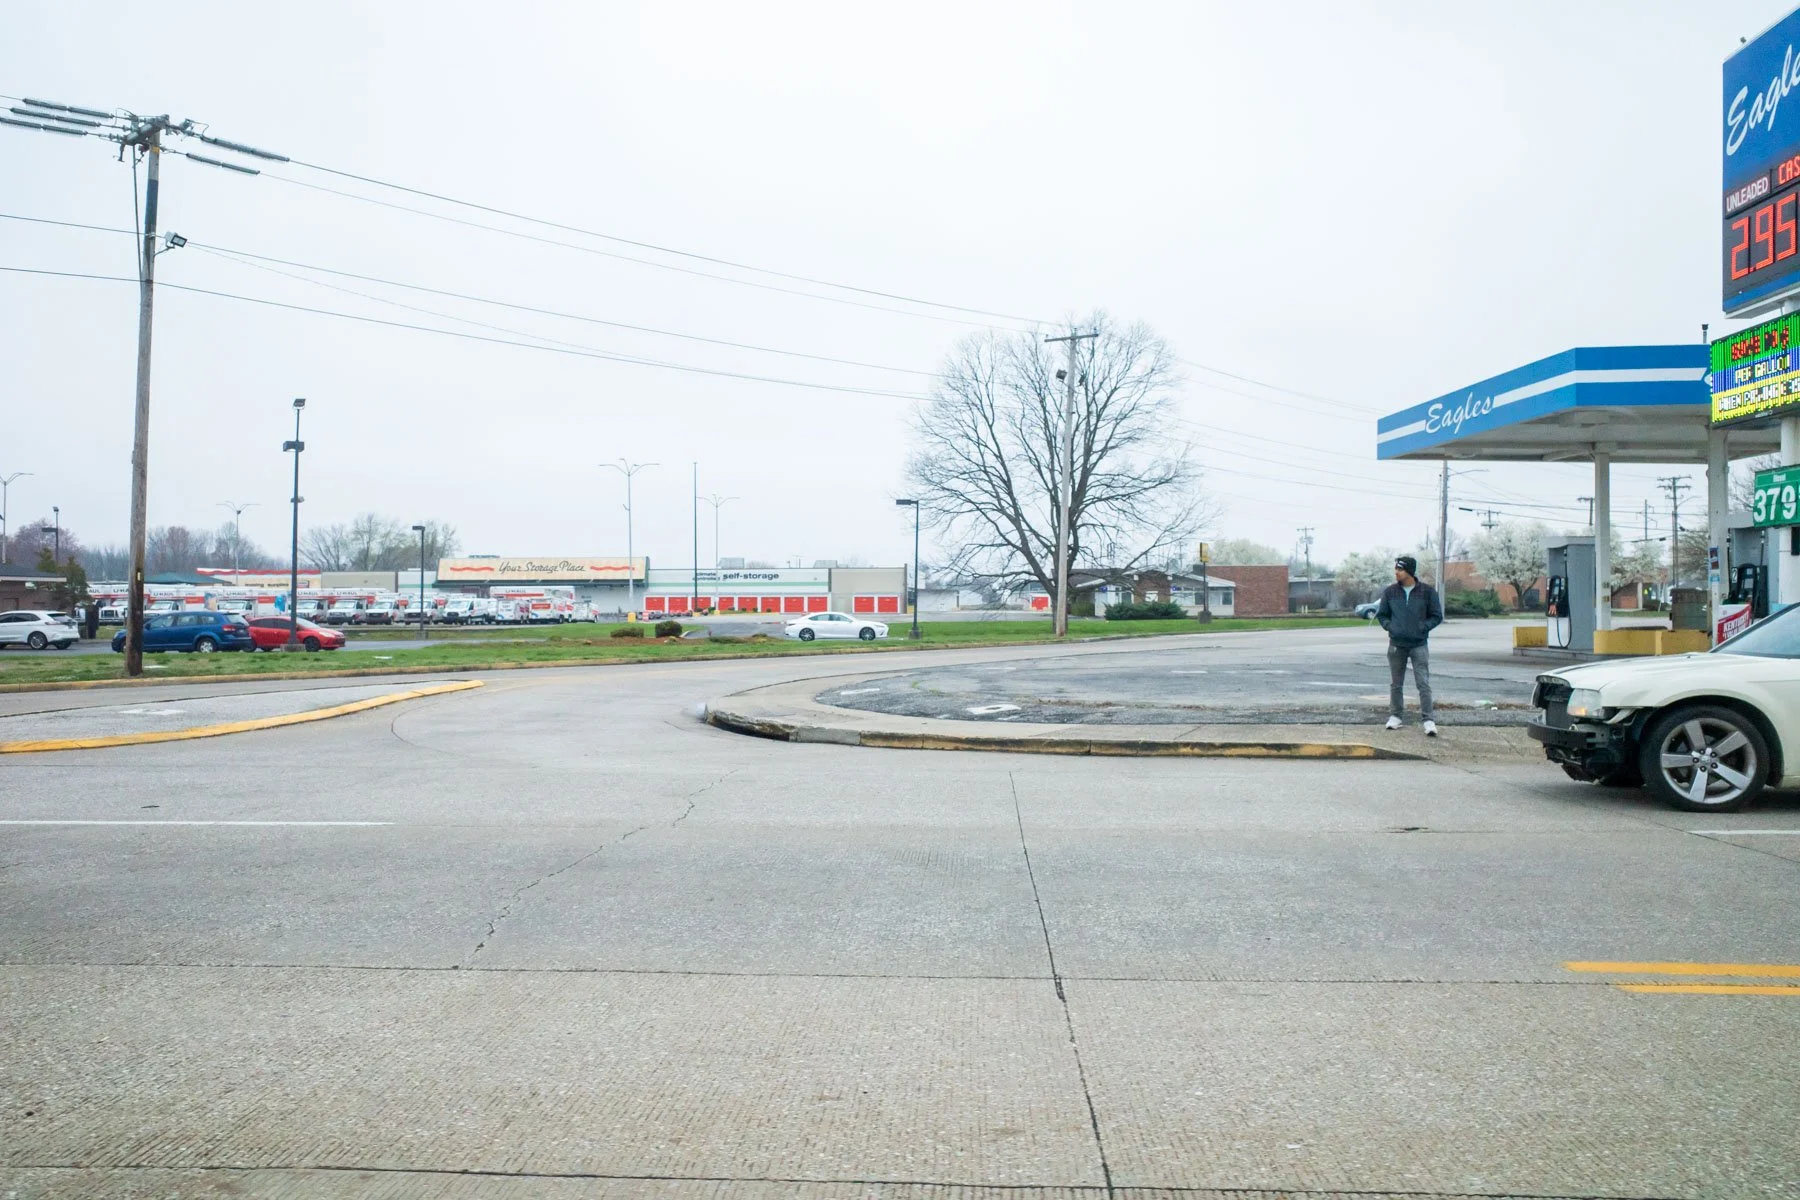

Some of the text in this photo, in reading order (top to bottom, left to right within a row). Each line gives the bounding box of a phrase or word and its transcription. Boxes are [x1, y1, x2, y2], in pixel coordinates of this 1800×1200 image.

[1726, 176, 1769, 212] UNLEADED
[1731, 192, 1797, 280] 2.95
[1425, 391, 1492, 435] Eagles
[1719, 393, 1742, 411] WHEN
[1753, 485, 1797, 523] 379
[499, 560, 587, 574] Your Storage Place
[722, 572, 780, 581] self-storage
